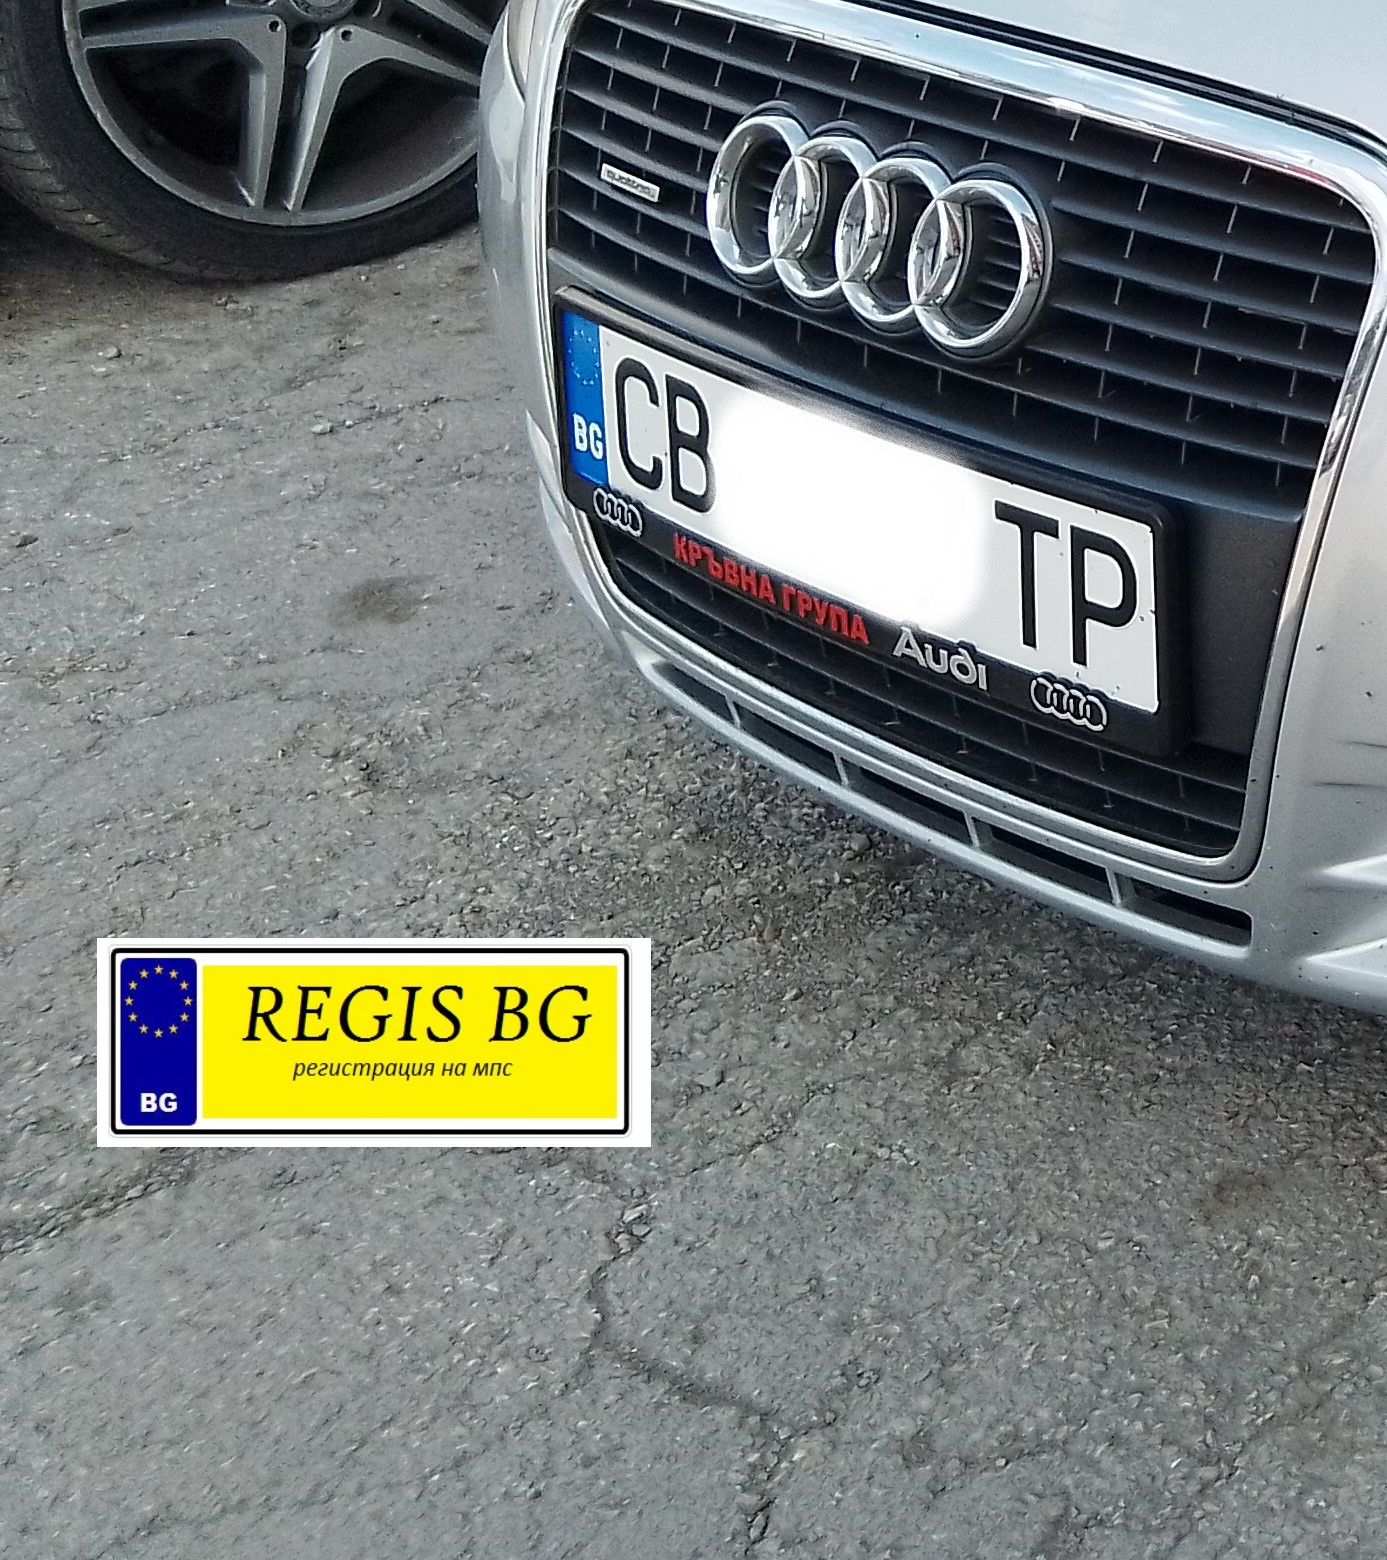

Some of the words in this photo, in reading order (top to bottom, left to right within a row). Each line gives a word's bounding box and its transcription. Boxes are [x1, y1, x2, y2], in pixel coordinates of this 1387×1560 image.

[572, 412, 604, 460] BG
[672, 531, 776, 605] КРЪВНА
[781, 583, 870, 645] ГРУПА
[892, 626, 988, 691] Audi
